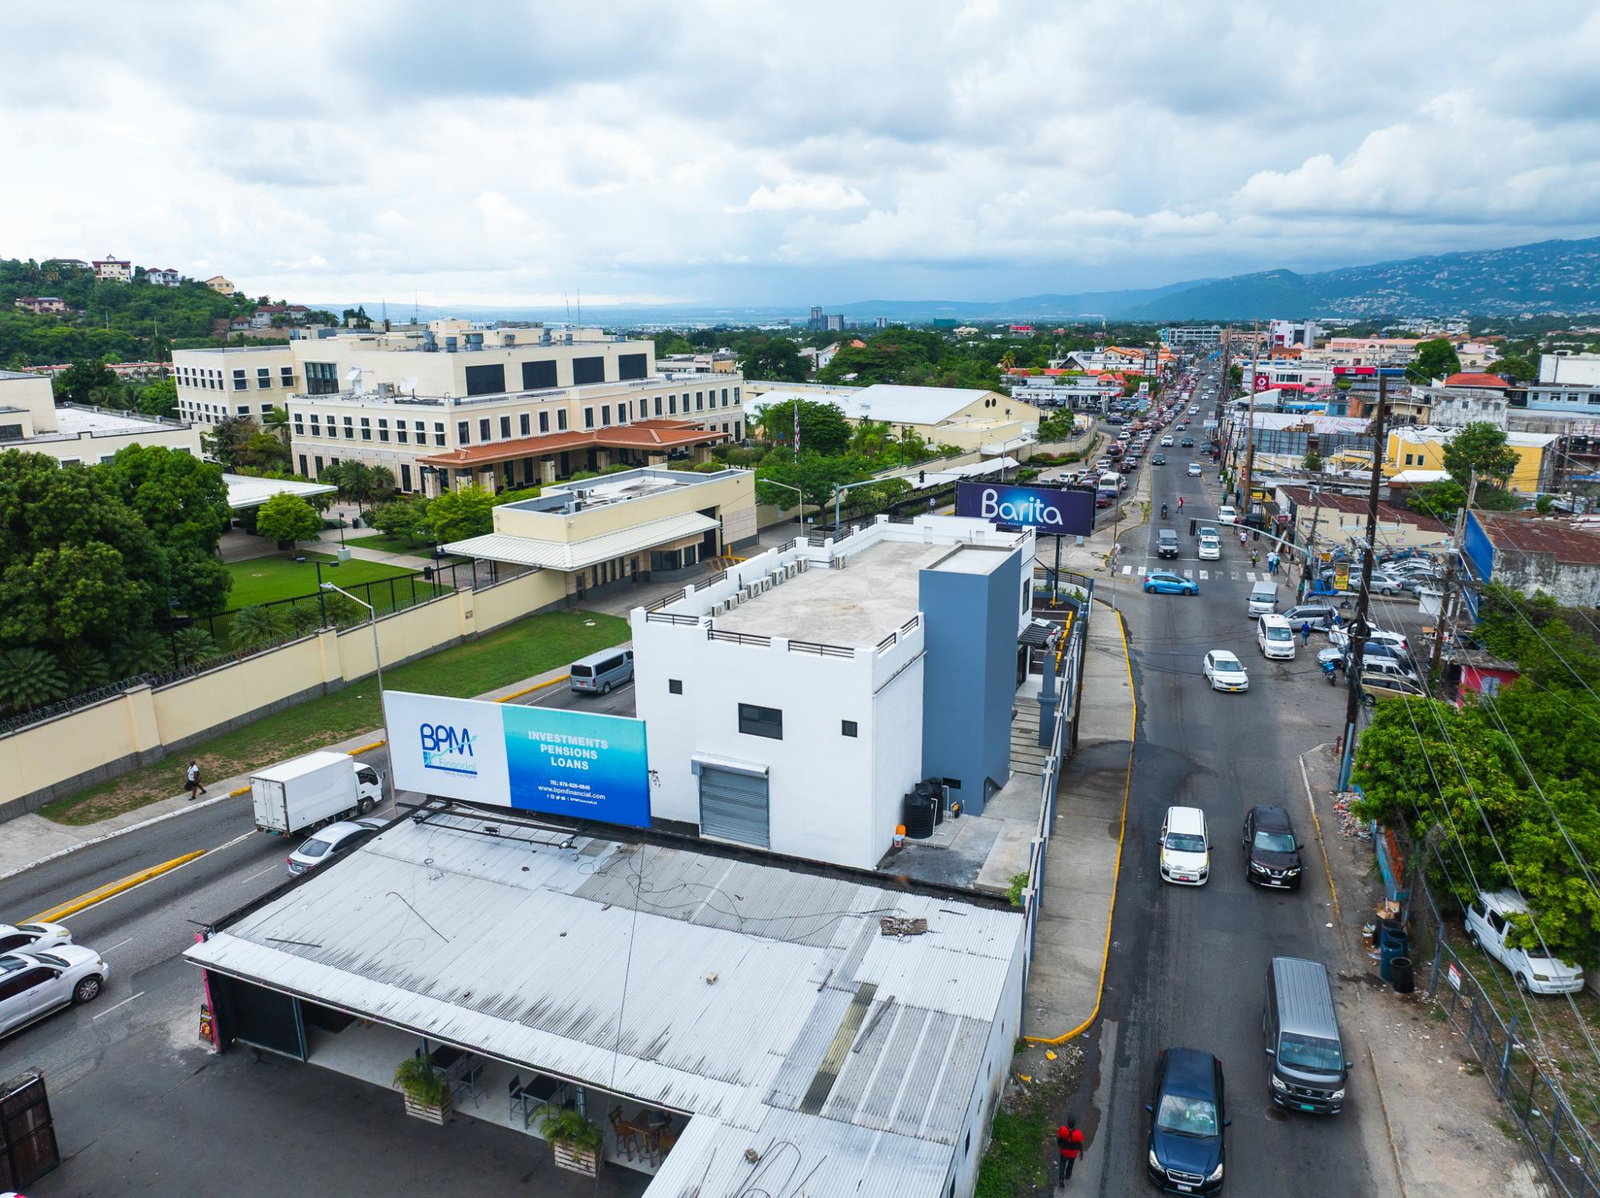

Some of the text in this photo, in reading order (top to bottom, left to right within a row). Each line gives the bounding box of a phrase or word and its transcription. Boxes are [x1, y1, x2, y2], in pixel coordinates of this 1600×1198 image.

[981, 488, 1064, 525] Barita
[420, 723, 474, 757] BPM
[528, 730, 609, 749] INVESTMENTS
[540, 743, 598, 760] PENSIONS
[551, 757, 589, 770] LOANS
[538, 785, 606, 800] www.bpmfinancial.com
